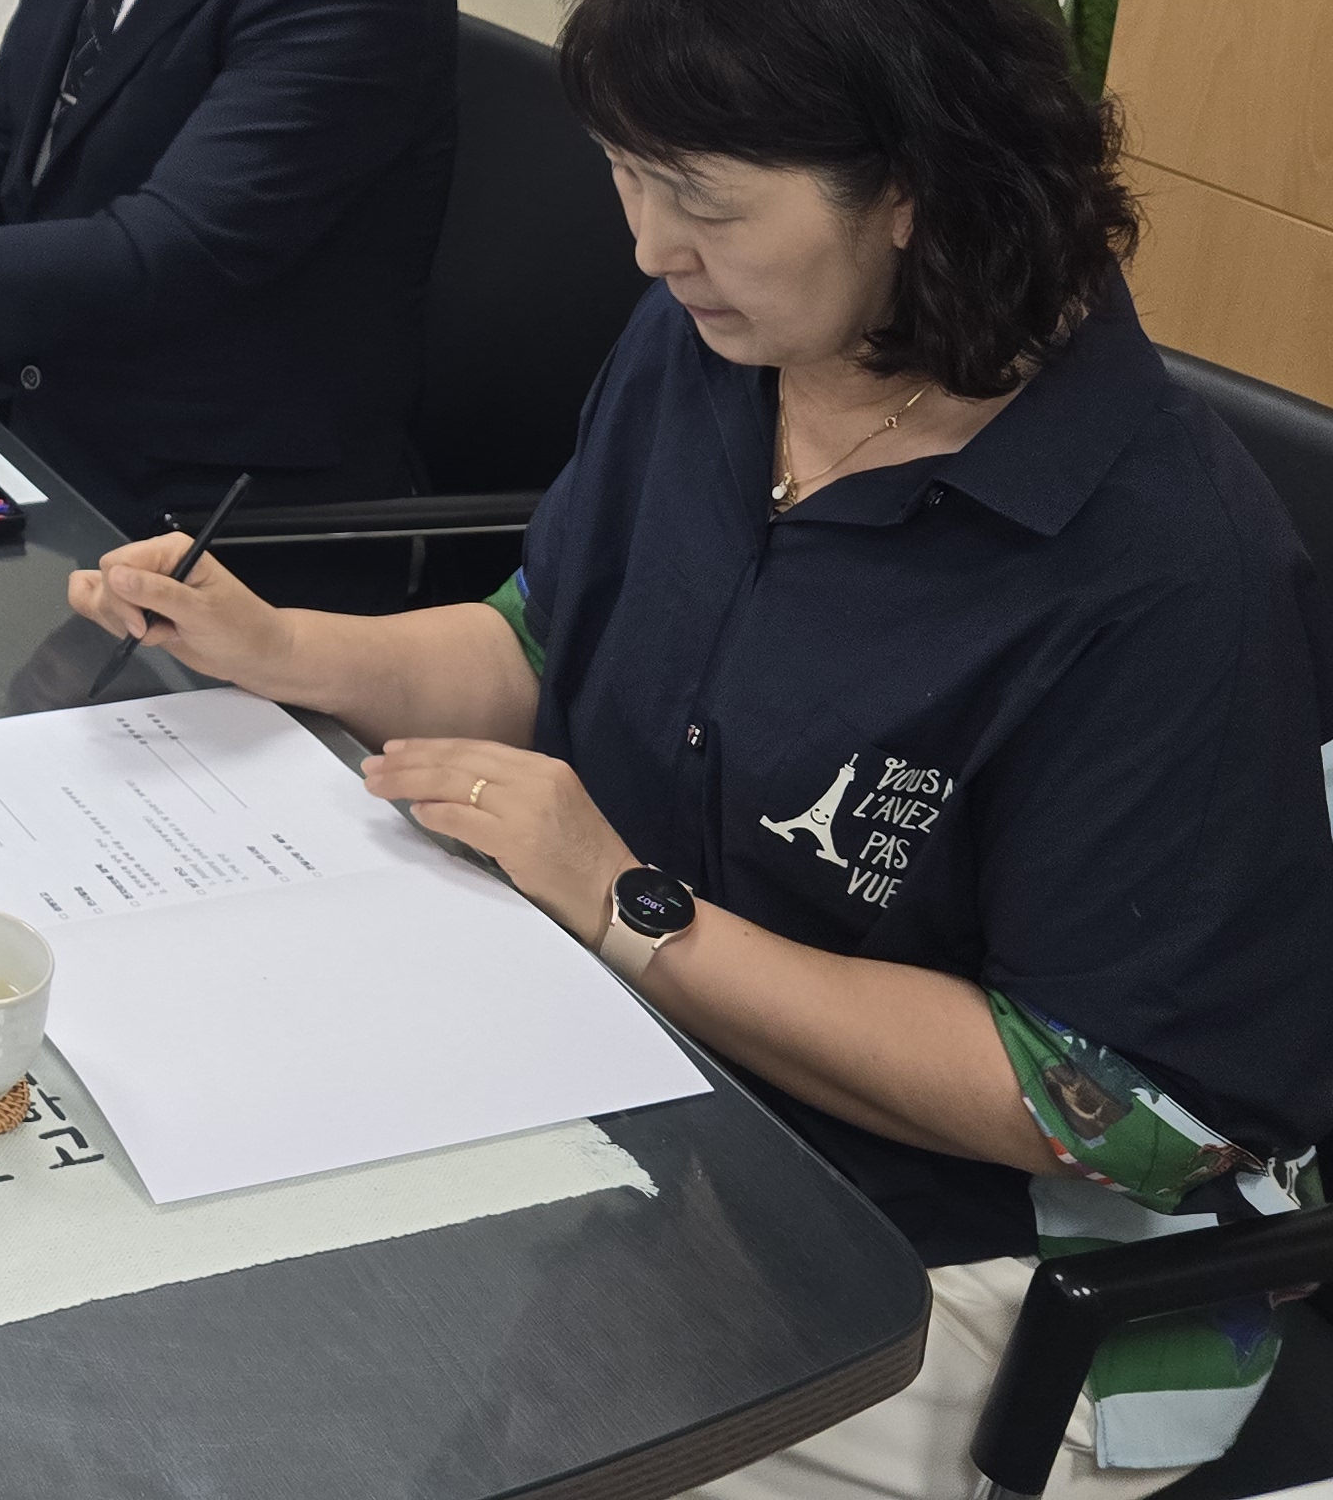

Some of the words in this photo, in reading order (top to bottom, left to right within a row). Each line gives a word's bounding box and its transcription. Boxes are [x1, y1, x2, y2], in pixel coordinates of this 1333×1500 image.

[876, 757, 941, 794] VOUS
[853, 792, 939, 833] L'AVEZ
[859, 830, 910, 869] PAS
[847, 867, 902, 908] VUE
